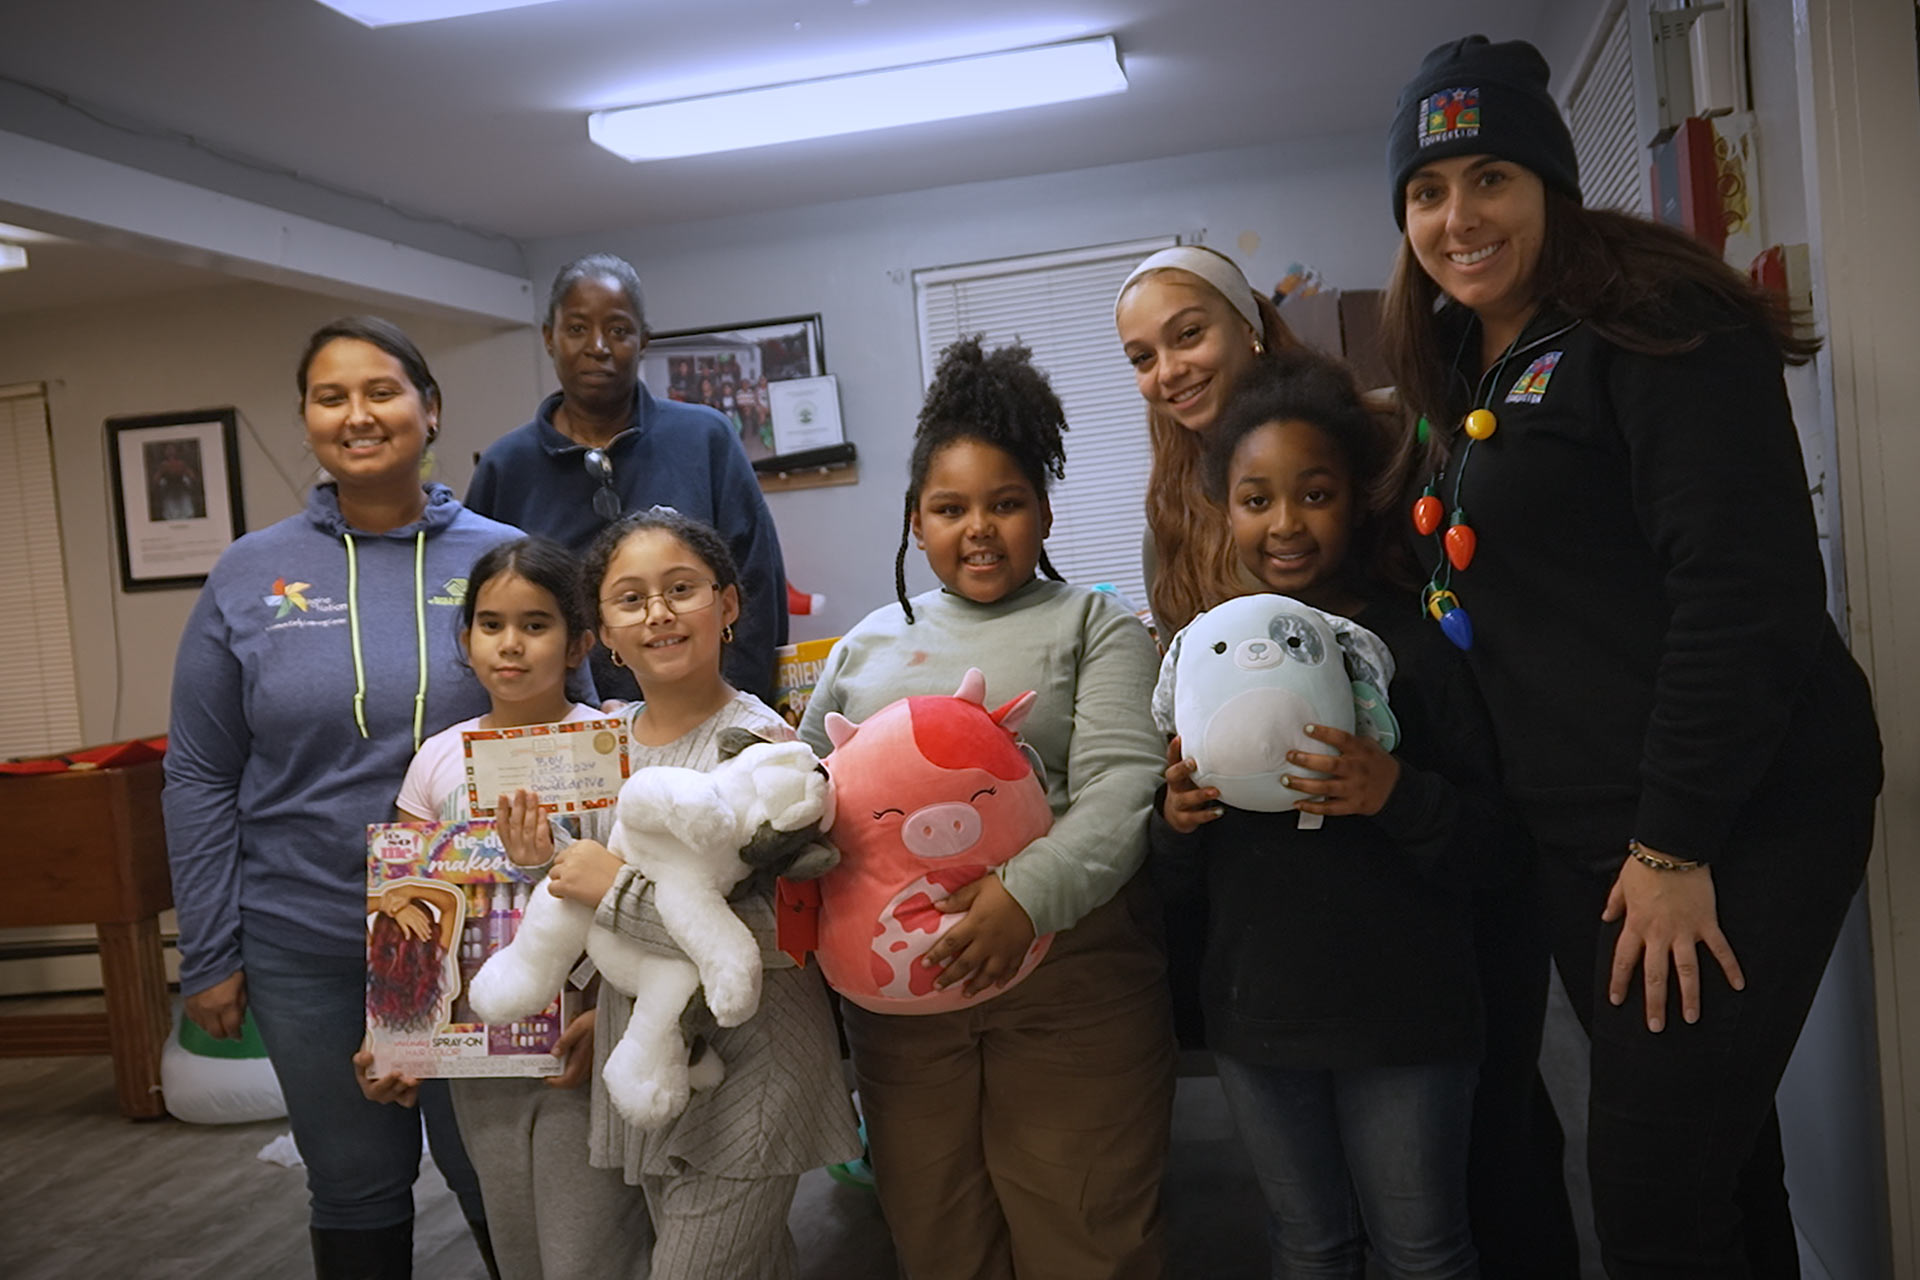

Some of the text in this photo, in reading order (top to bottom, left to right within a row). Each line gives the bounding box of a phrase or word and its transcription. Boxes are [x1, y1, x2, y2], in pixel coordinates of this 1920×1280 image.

[779, 658, 828, 690] FRIEN
[453, 831, 506, 852] tie-dy
[432, 1036, 484, 1047] SPRAY-ON
